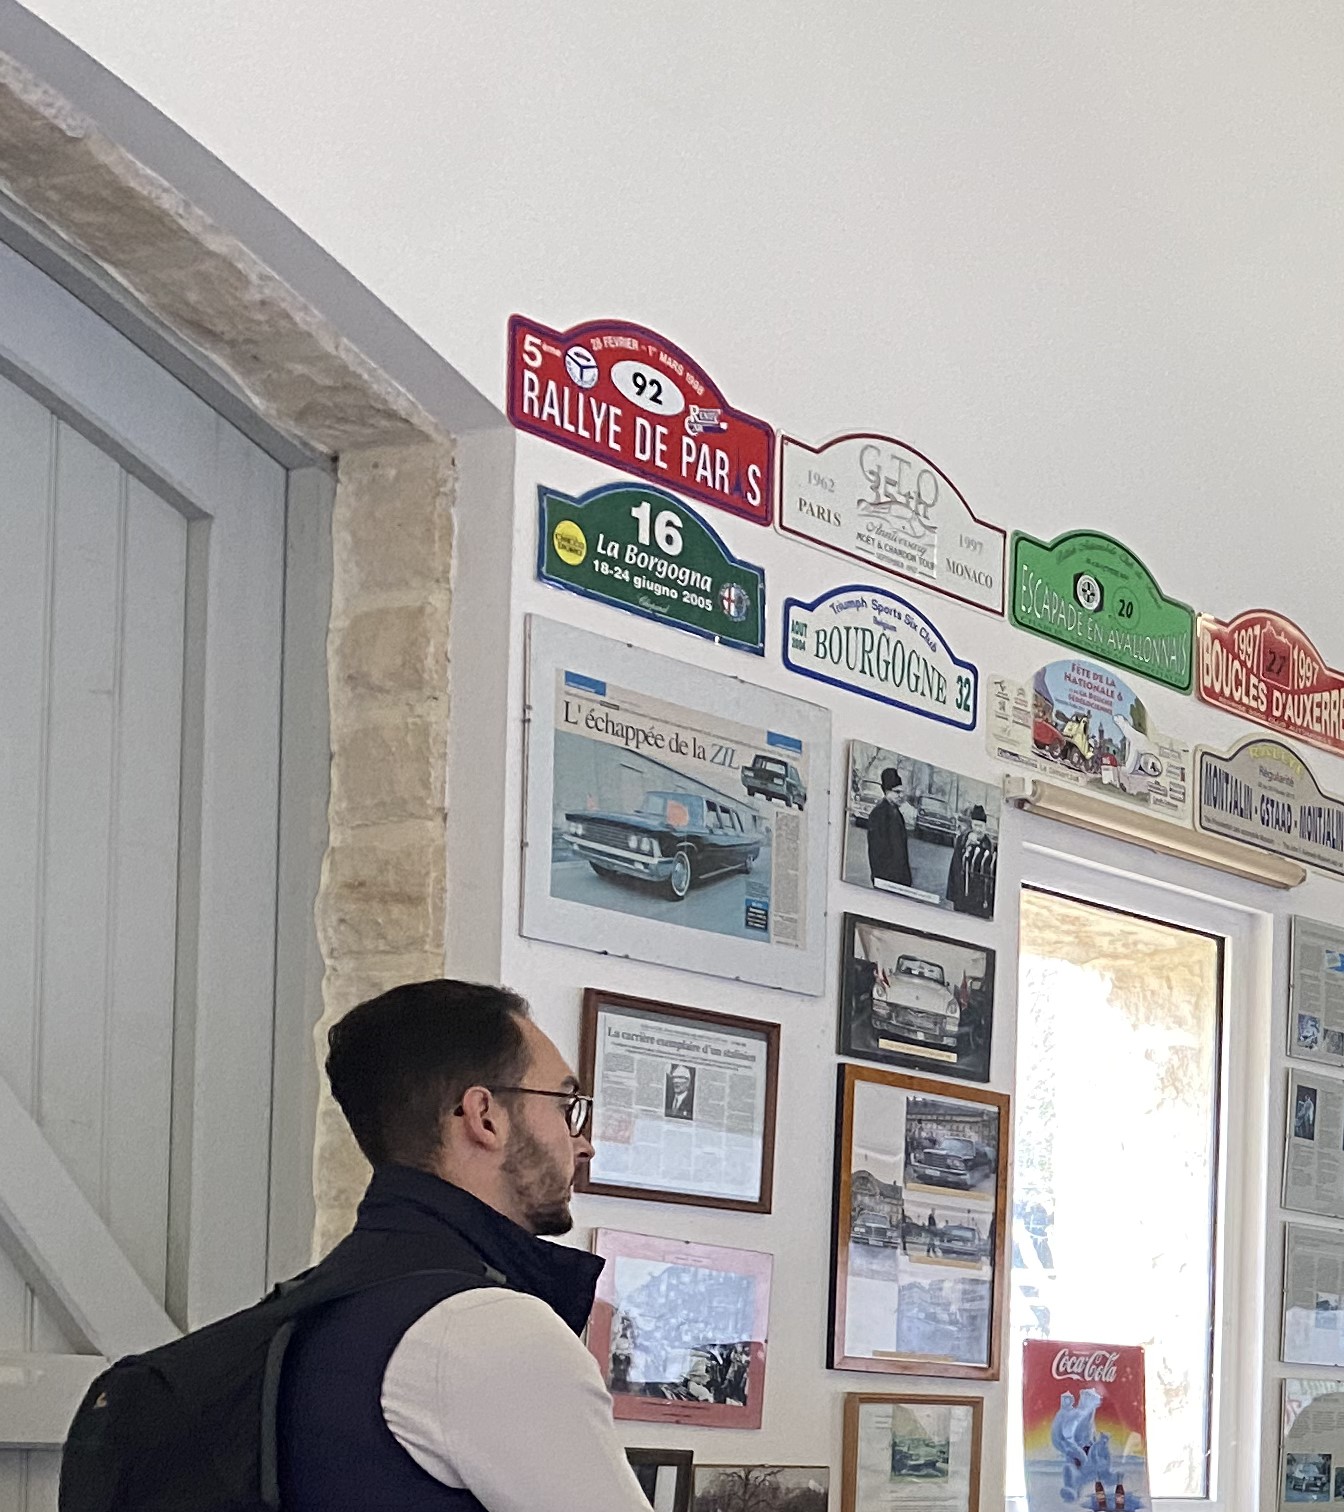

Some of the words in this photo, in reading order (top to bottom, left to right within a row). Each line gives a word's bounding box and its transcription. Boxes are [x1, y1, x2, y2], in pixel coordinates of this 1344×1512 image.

[632, 372, 662, 405] 92
[522, 369, 622, 451] RALLYE
[635, 416, 668, 470] DE
[631, 501, 683, 556] 16
[807, 469, 835, 493] 1962
[959, 534, 984, 555] 1997
[596, 534, 620, 560] La
[625, 544, 713, 593] Borgogna
[798, 497, 842, 527] PARIS
[946, 557, 993, 589] MONACO
[593, 559, 630, 583] 18-24
[633, 576, 678, 600] giugno
[682, 590, 713, 612] 2005
[1020, 564, 1083, 637] ESCAPADE
[1087, 618, 1104, 645] EN
[1118, 599, 1134, 619] 20
[829, 596, 868, 616] Triumph
[871, 599, 902, 620] Sports
[903, 614, 918, 632] Six
[919, 627, 937, 653] Club
[814, 625, 948, 706] BOURGOGNE
[1106, 676, 1116, 687] LA
[1203, 627, 1268, 712] BOUCLES
[1234, 624, 1261, 675] 1997
[1266, 648, 1286, 676] 27
[1293, 645, 1320, 690] 1997
[956, 675, 972, 713] 32
[669, 732, 689, 756] de
[692, 737, 706, 761] la
[710, 743, 741, 770] ZIL
[1260, 794, 1292, 834] GSTAAD
[1052, 1348, 1120, 1384] Coca-Cola
